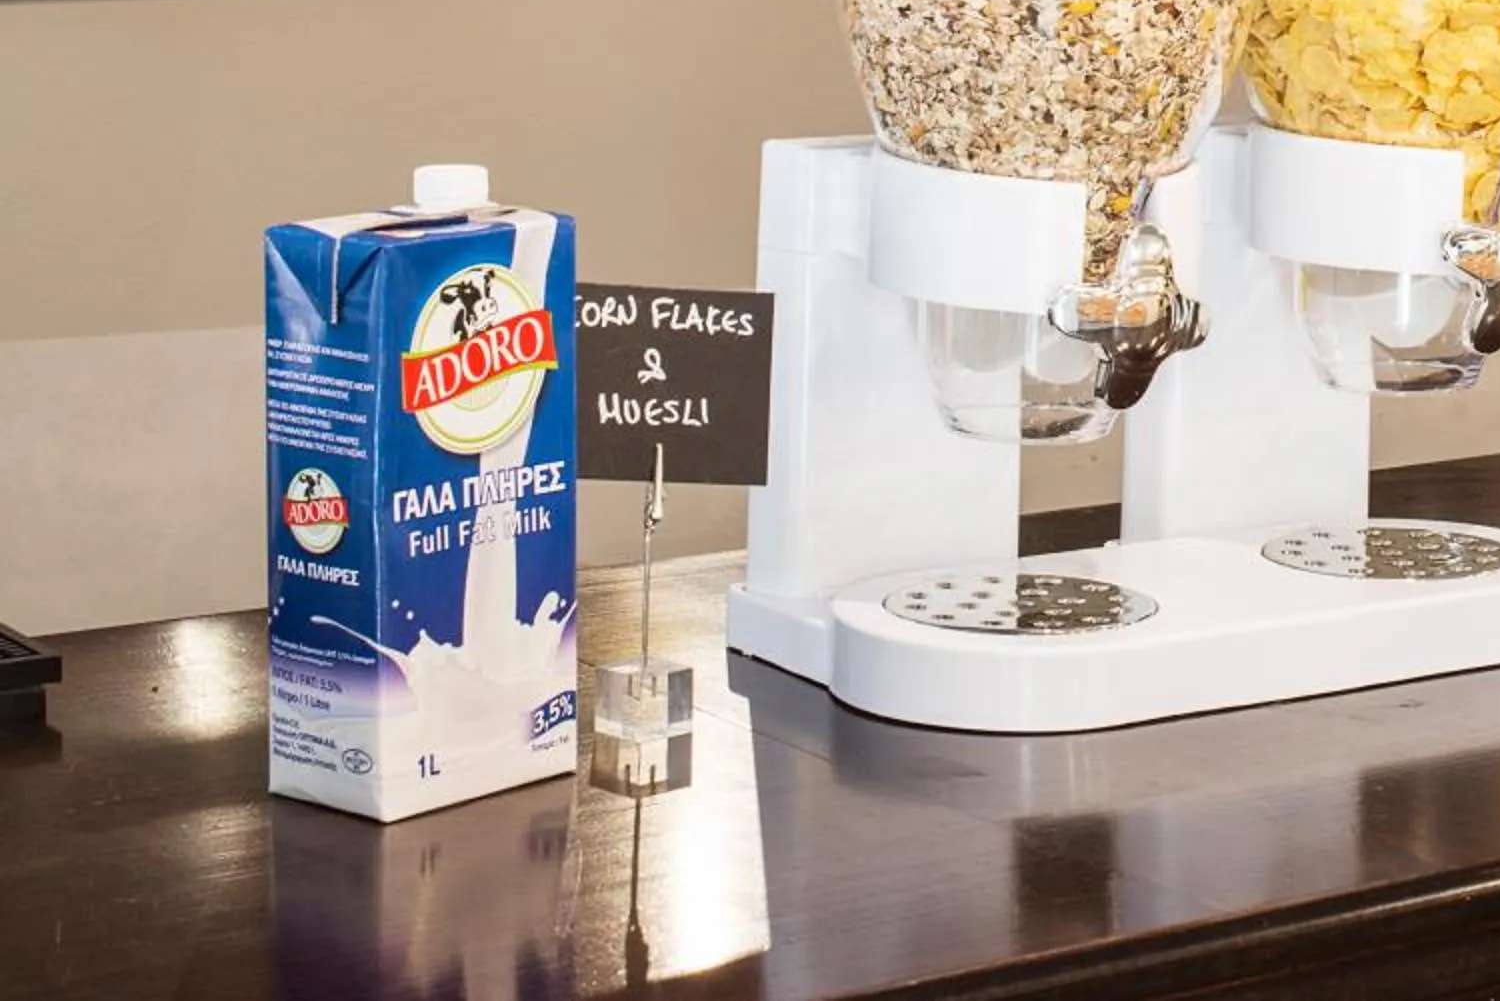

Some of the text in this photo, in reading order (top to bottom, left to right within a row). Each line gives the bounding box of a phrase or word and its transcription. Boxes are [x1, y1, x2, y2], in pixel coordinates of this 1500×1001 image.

[651, 297, 755, 336] FLAKES
[412, 316, 545, 408] ADORO
[637, 348, 667, 384] &
[598, 392, 710, 427] MUESLI
[393, 460, 567, 523] ΓΑΛΑ ΠΛΗΡΕΣ
[288, 500, 344, 524] ADORO
[408, 505, 552, 558] Full Fat Milk
[277, 554, 360, 587] ΓΑΛΑ ΠΛΗΡΕΣ
[532, 693, 574, 734] 3,5%
